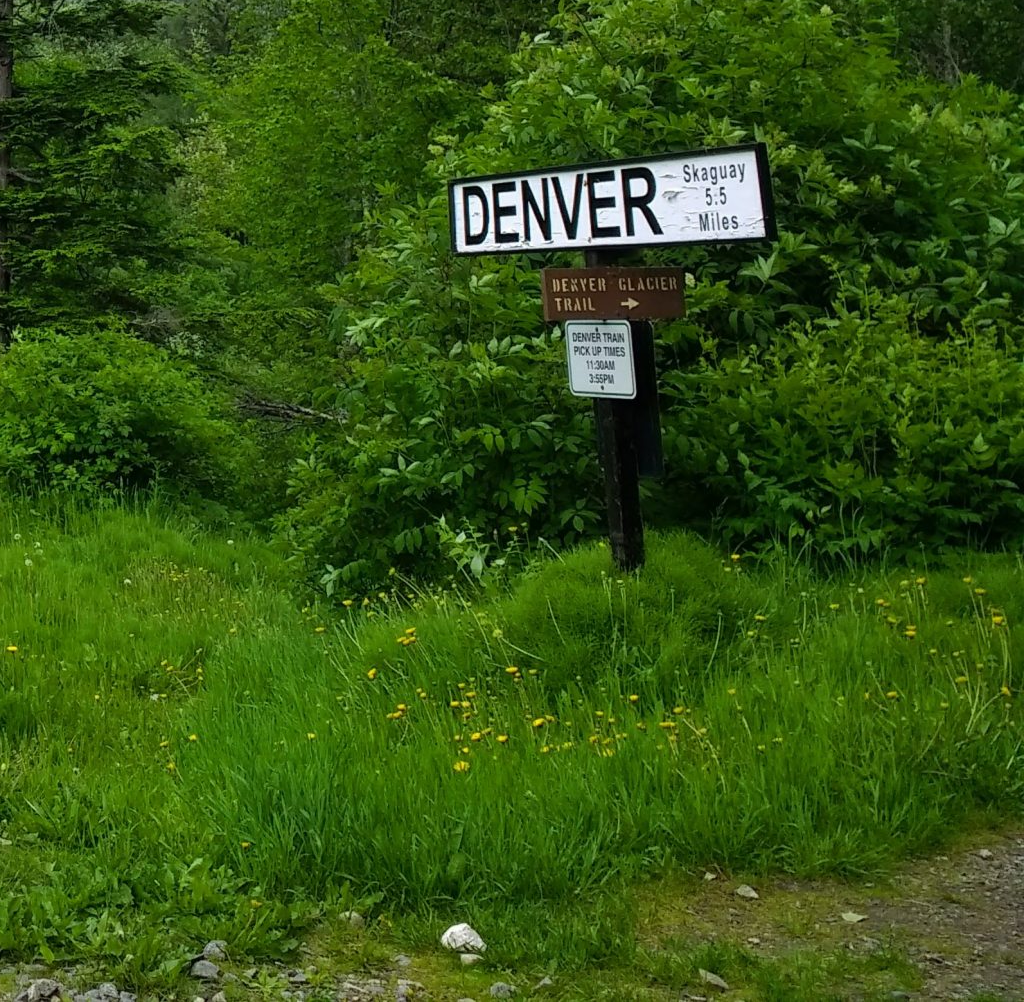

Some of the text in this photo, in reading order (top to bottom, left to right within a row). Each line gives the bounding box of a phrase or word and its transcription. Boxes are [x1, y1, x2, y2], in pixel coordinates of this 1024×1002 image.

[682, 162, 746, 185] Skaguay
[705, 187, 727, 206] 5.5
[462, 167, 663, 246] DENVER
[698, 213, 739, 232] Miles
[552, 277, 677, 292] DENVER GLACIER
[554, 297, 596, 311] TRAIL
[572, 332, 625, 343] DENVER TRAIN
[573, 346, 626, 357] PICK UP TIMES
[586, 360, 616, 370] 11:30AM
[589, 374, 615, 384] 3:55PM
